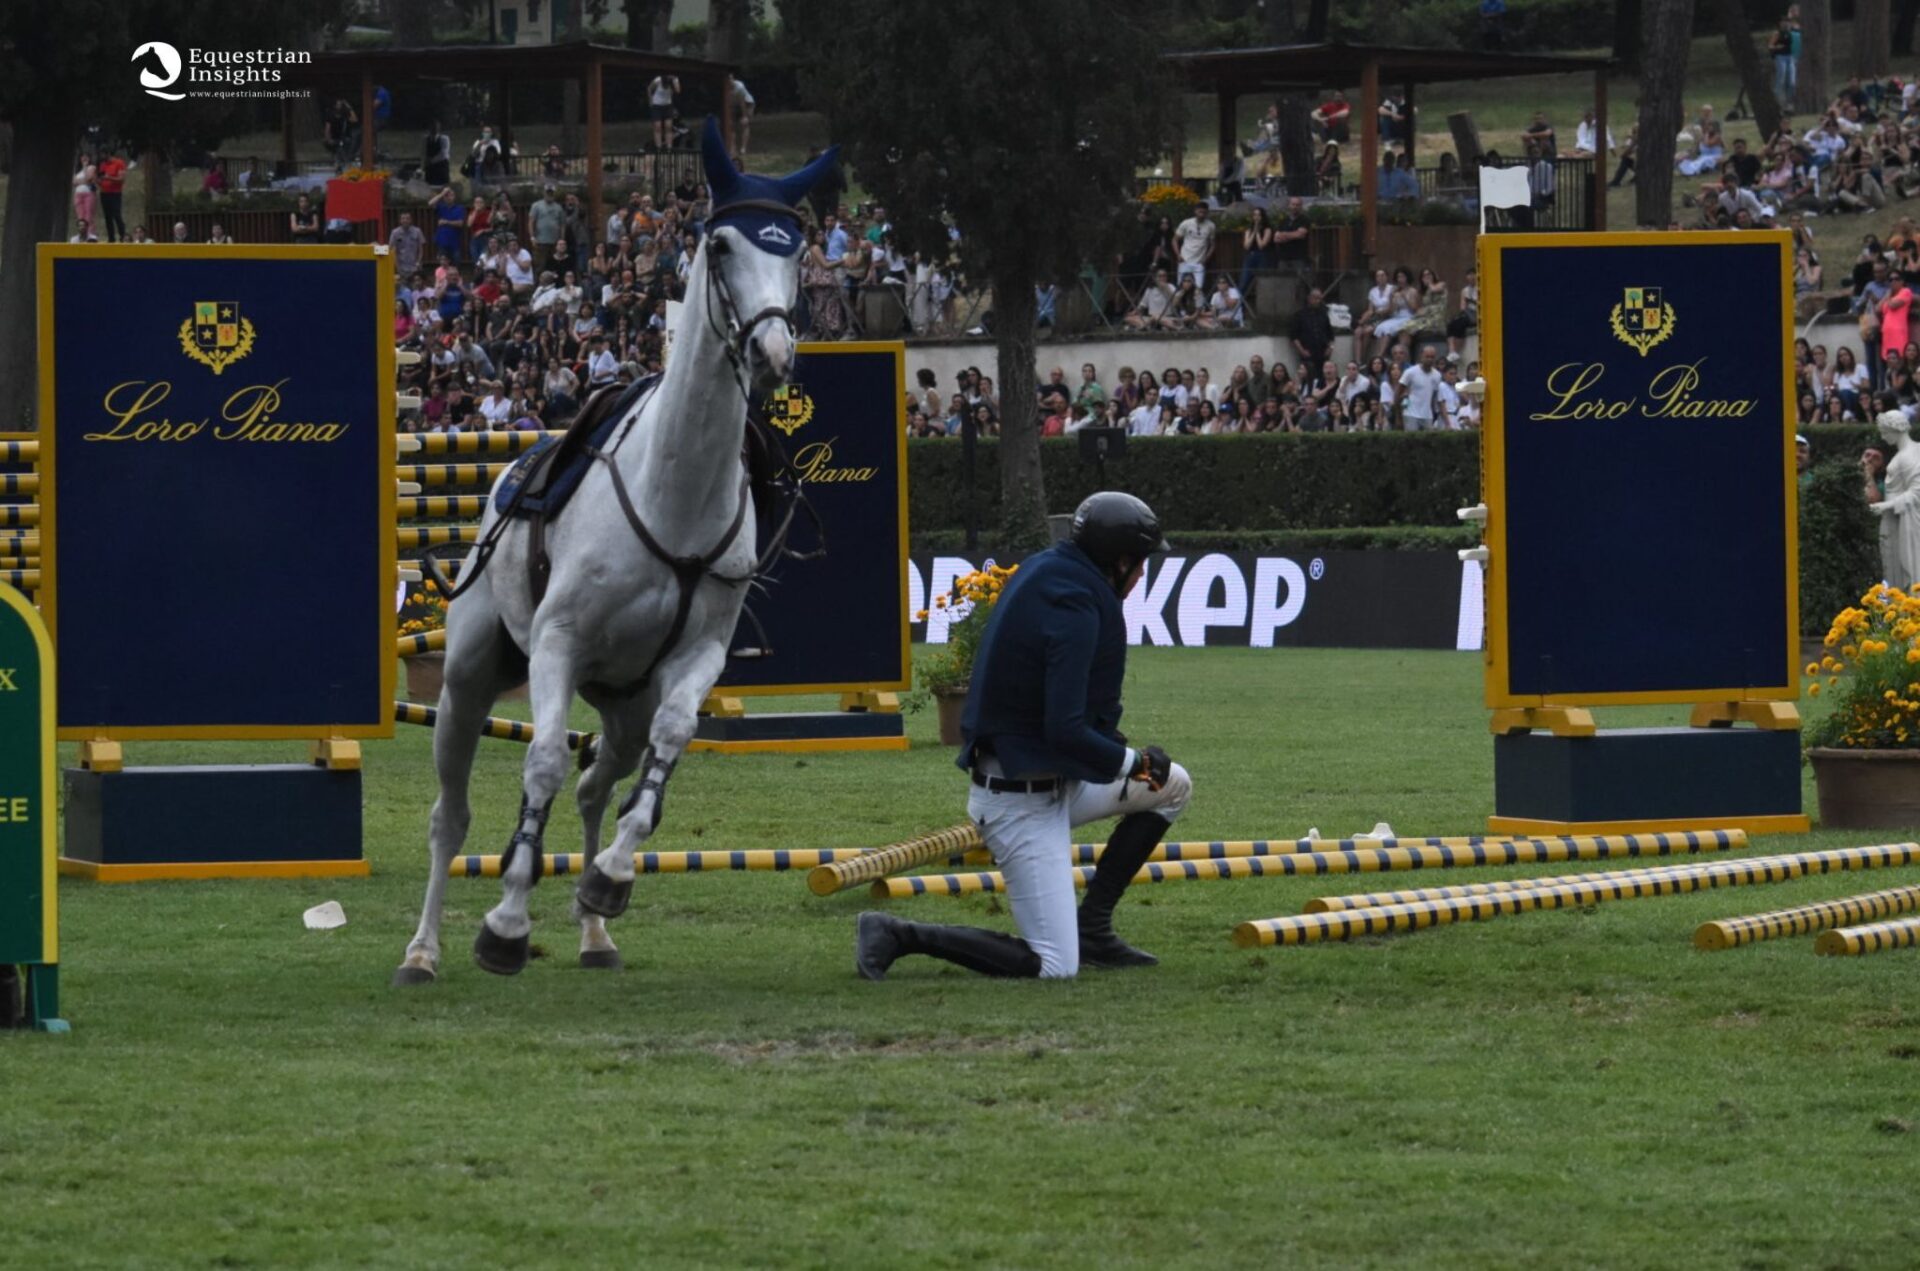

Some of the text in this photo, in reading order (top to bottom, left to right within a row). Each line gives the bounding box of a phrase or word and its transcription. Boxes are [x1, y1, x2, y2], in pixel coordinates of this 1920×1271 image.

[83, 377, 350, 442] Loro Piana
[1529, 356, 1760, 421] Loro Piana
[793, 436, 880, 483] Piana
